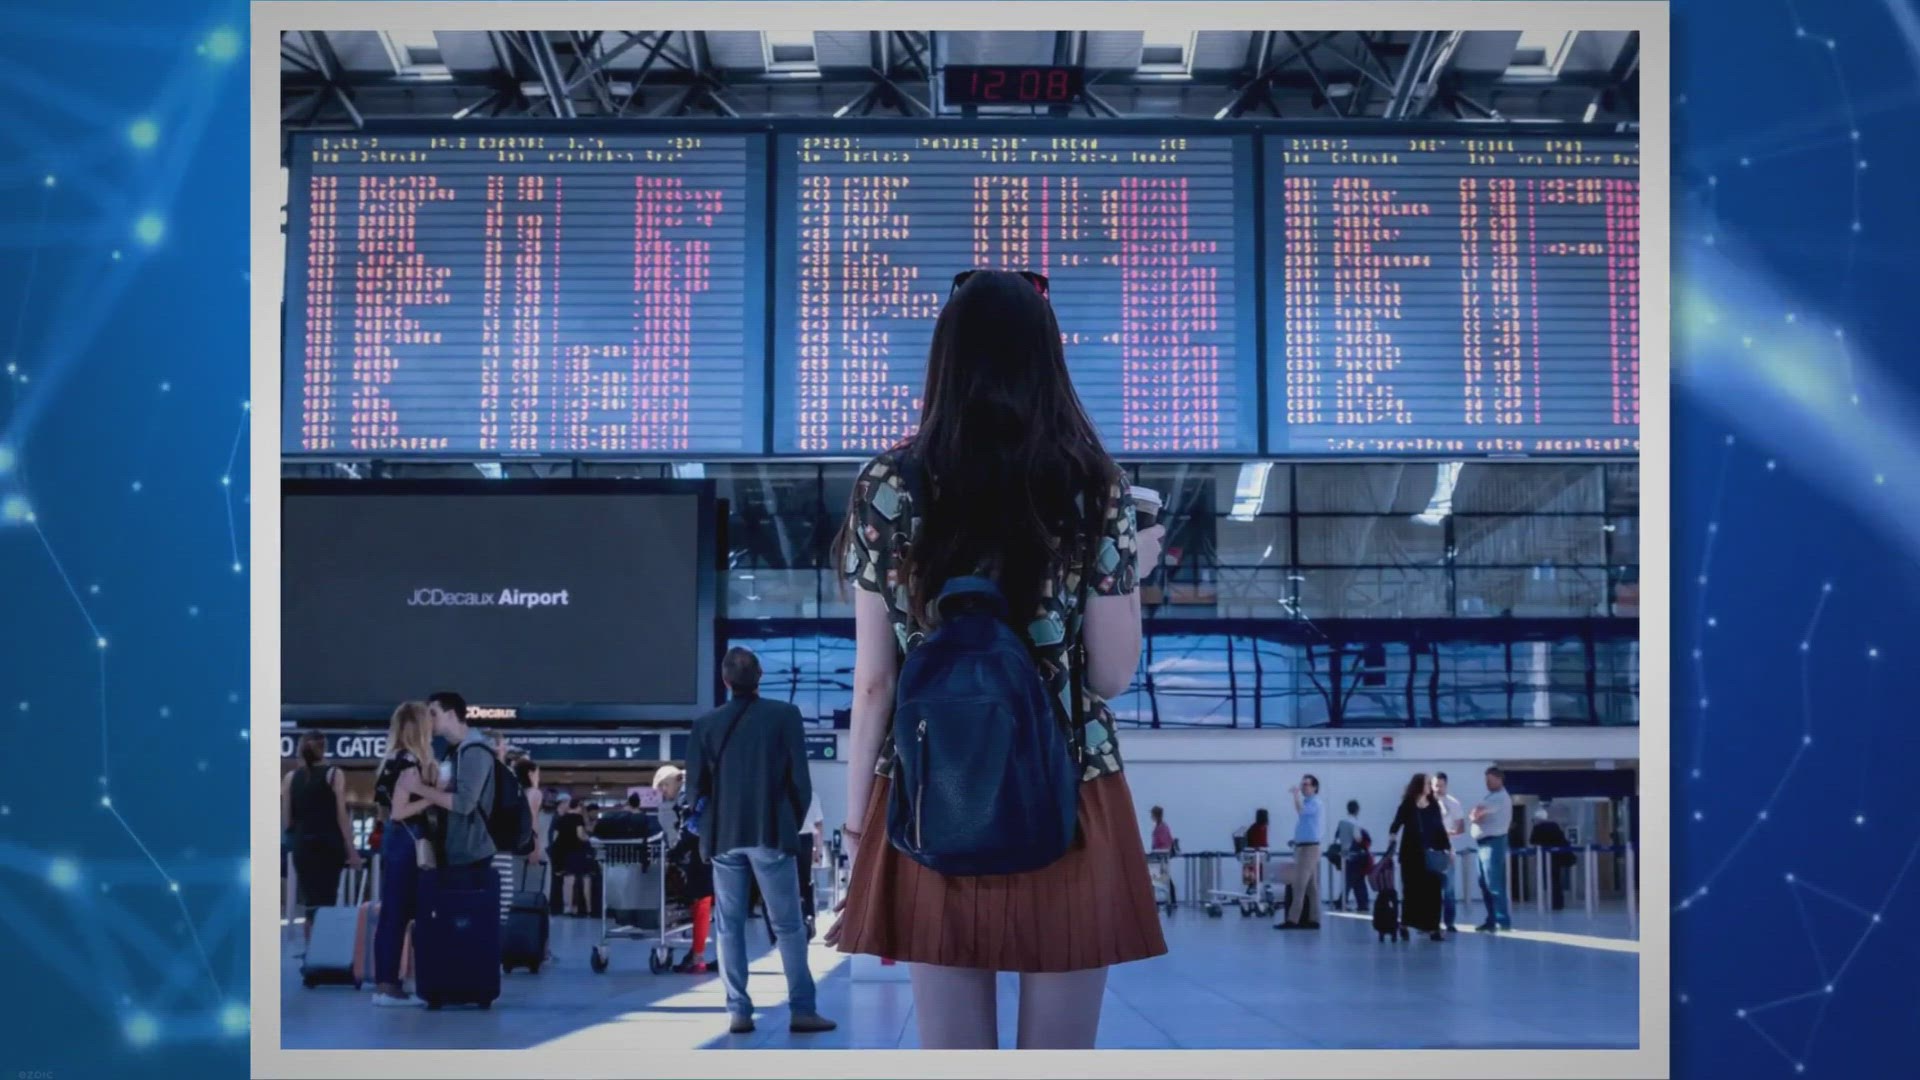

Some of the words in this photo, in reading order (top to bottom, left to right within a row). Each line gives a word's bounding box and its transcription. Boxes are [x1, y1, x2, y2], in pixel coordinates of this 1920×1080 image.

[407, 588, 494, 606] JCDecaux
[498, 588, 568, 608] Airport
[465, 706, 517, 719] CDecaux
[1301, 737, 1330, 748] FAST
[1333, 737, 1375, 748] TRACK
